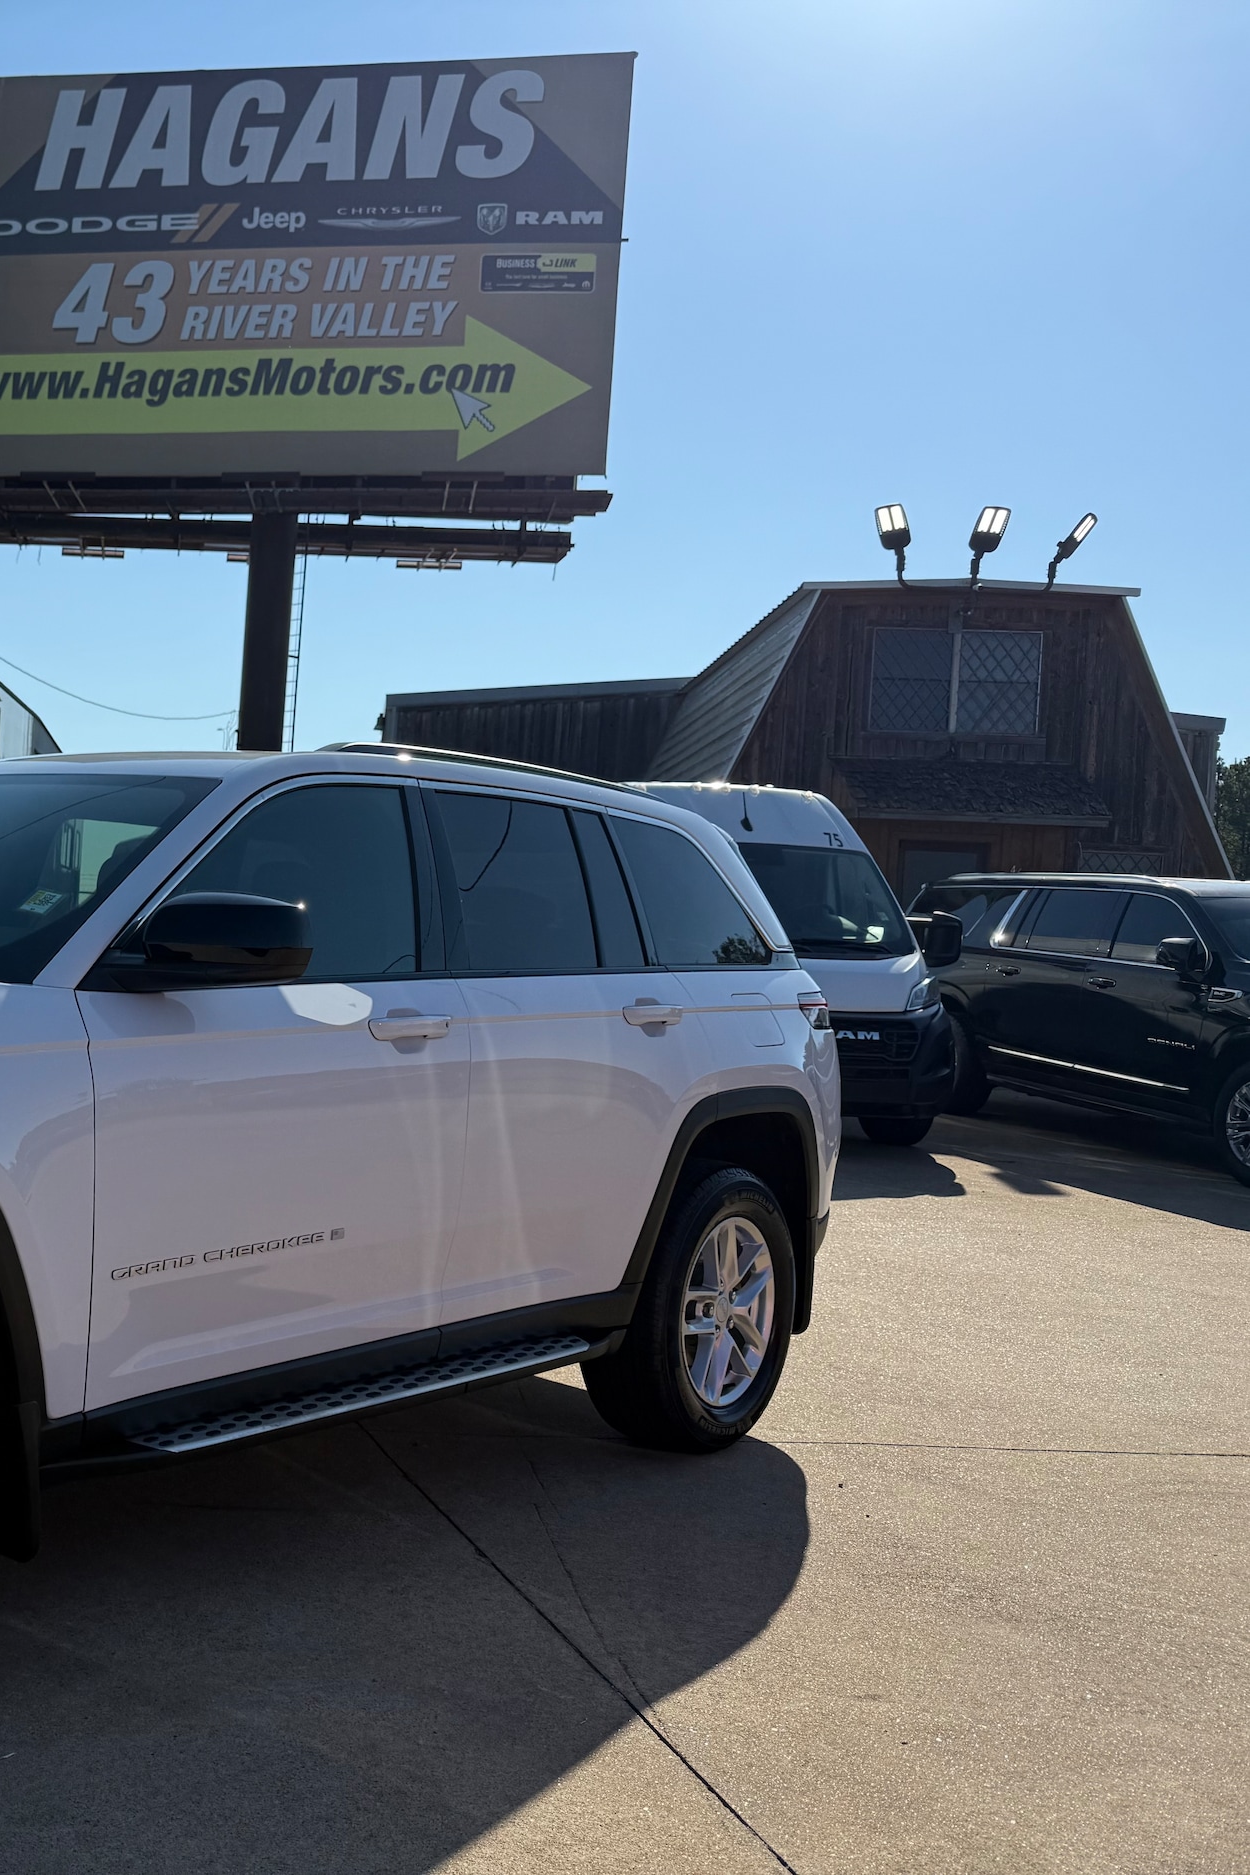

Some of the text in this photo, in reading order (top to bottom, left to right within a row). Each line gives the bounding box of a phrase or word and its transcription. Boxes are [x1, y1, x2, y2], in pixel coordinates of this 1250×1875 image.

[33, 69, 545, 192] HAGANS
[242, 206, 306, 232] Jeep
[336, 204, 443, 217] CHRYSLER
[515, 210, 604, 226] RAM
[187, 254, 456, 295] YEARS IN THE
[496, 258, 578, 269] BUSINESS LINK
[52, 259, 175, 345] 43
[180, 300, 459, 341] RIVER VALLEY
[823, 832, 844, 847] 75
[836, 1029, 880, 1041] AM
[111, 1231, 325, 1281] GRAND CHEROKEE
